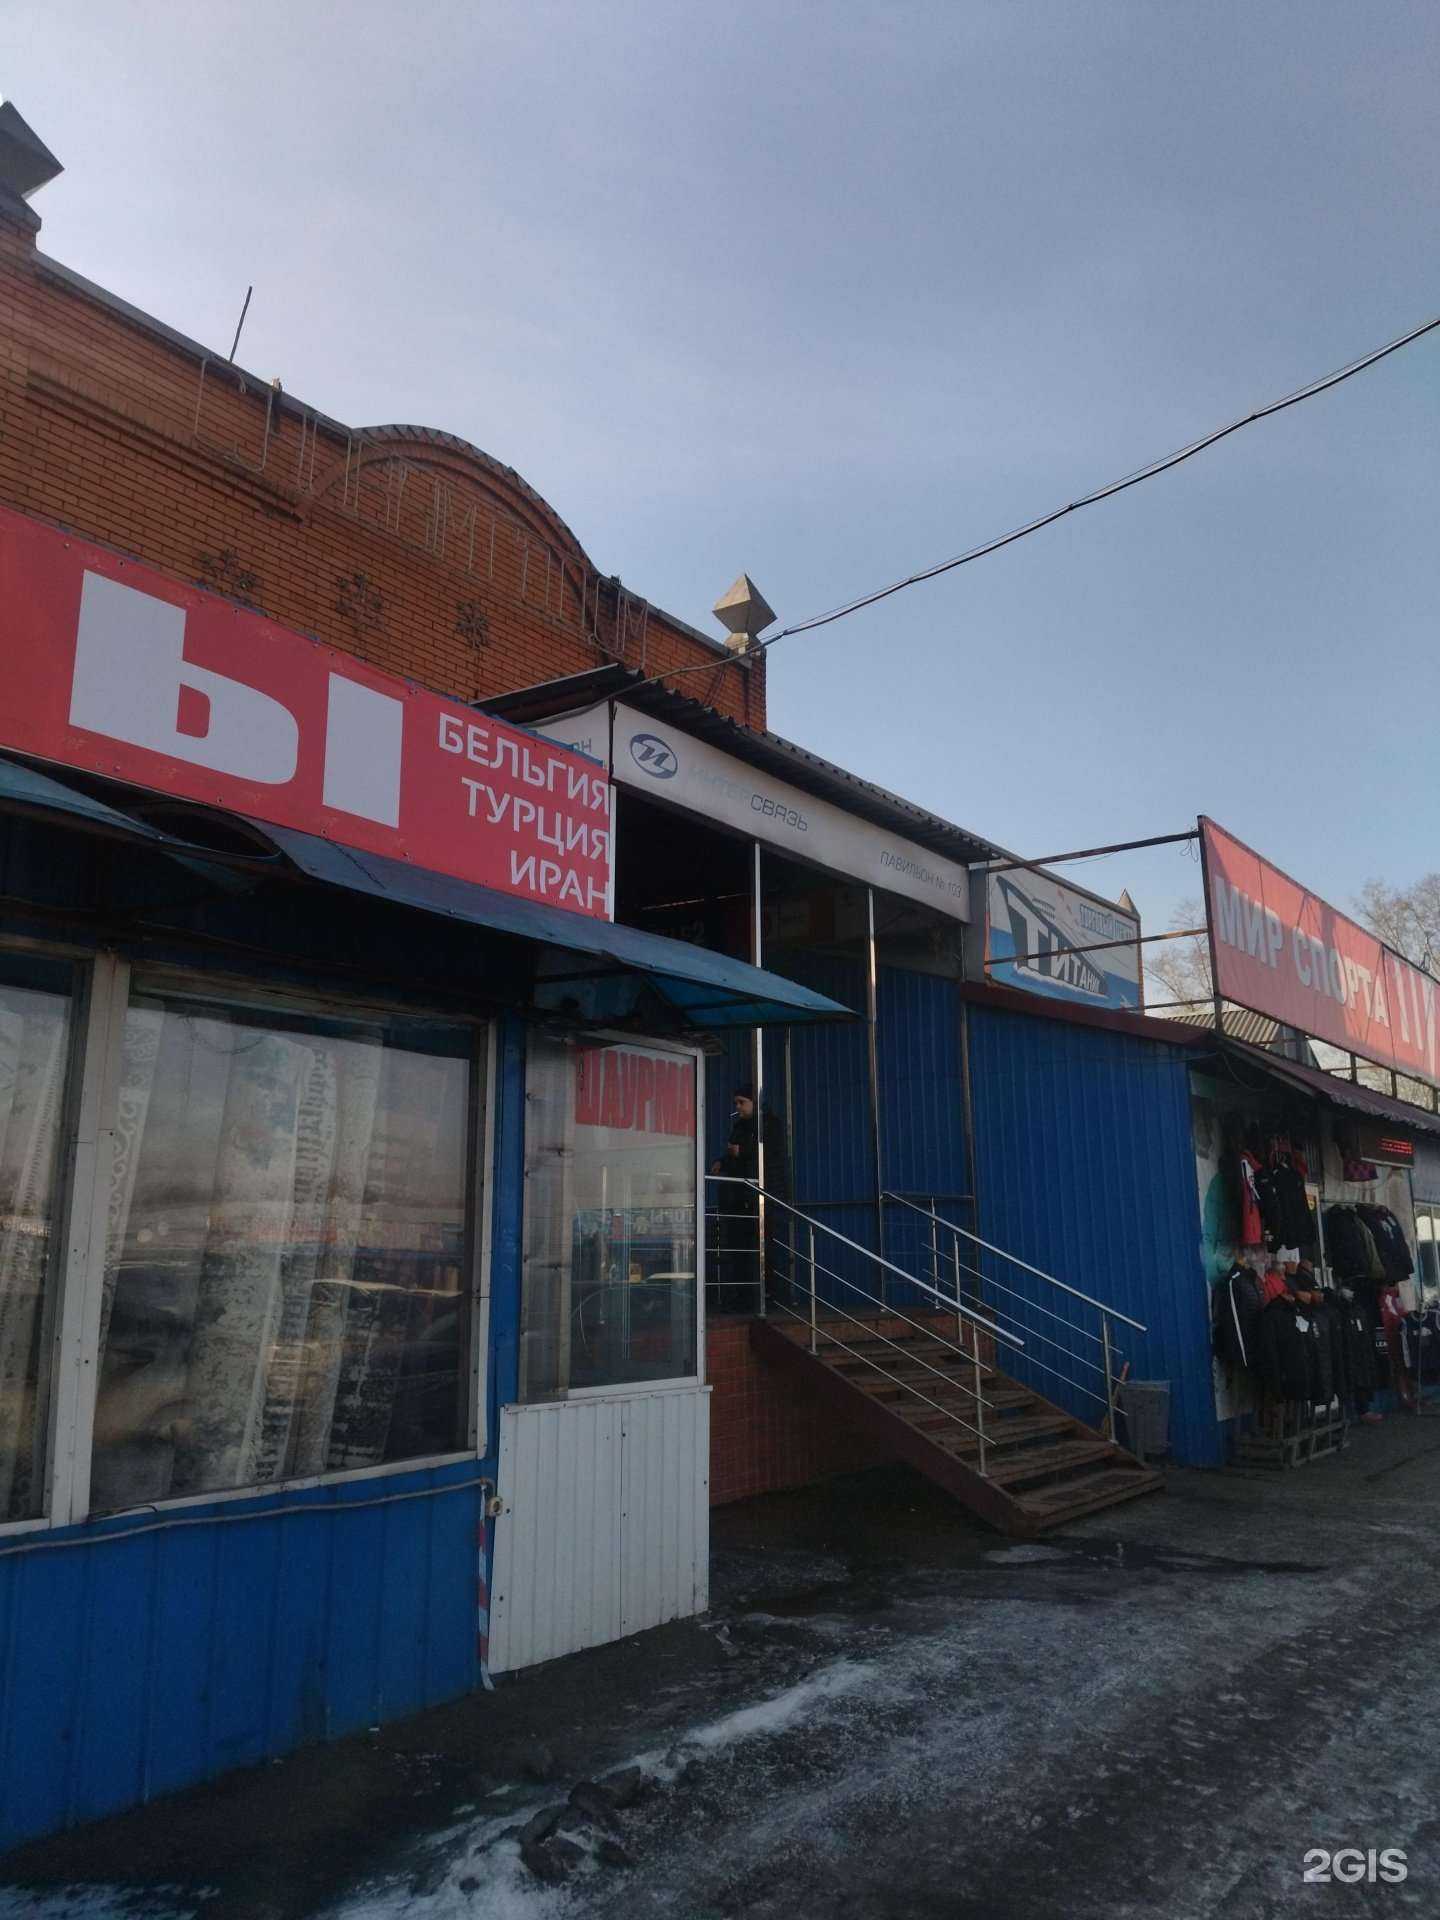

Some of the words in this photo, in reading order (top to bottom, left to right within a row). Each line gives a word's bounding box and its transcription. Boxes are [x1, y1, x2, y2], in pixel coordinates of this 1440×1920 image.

[438, 712, 609, 815] БЕЛЬГИЯ
[461, 777, 609, 864] ТУРЦИЯ
[511, 850, 609, 912] ИРАН
[880, 851, 935, 886] ПАВИЛЬОН
[1215, 875, 1283, 969] МИР
[1292, 926, 1389, 1029] СПОРТА
